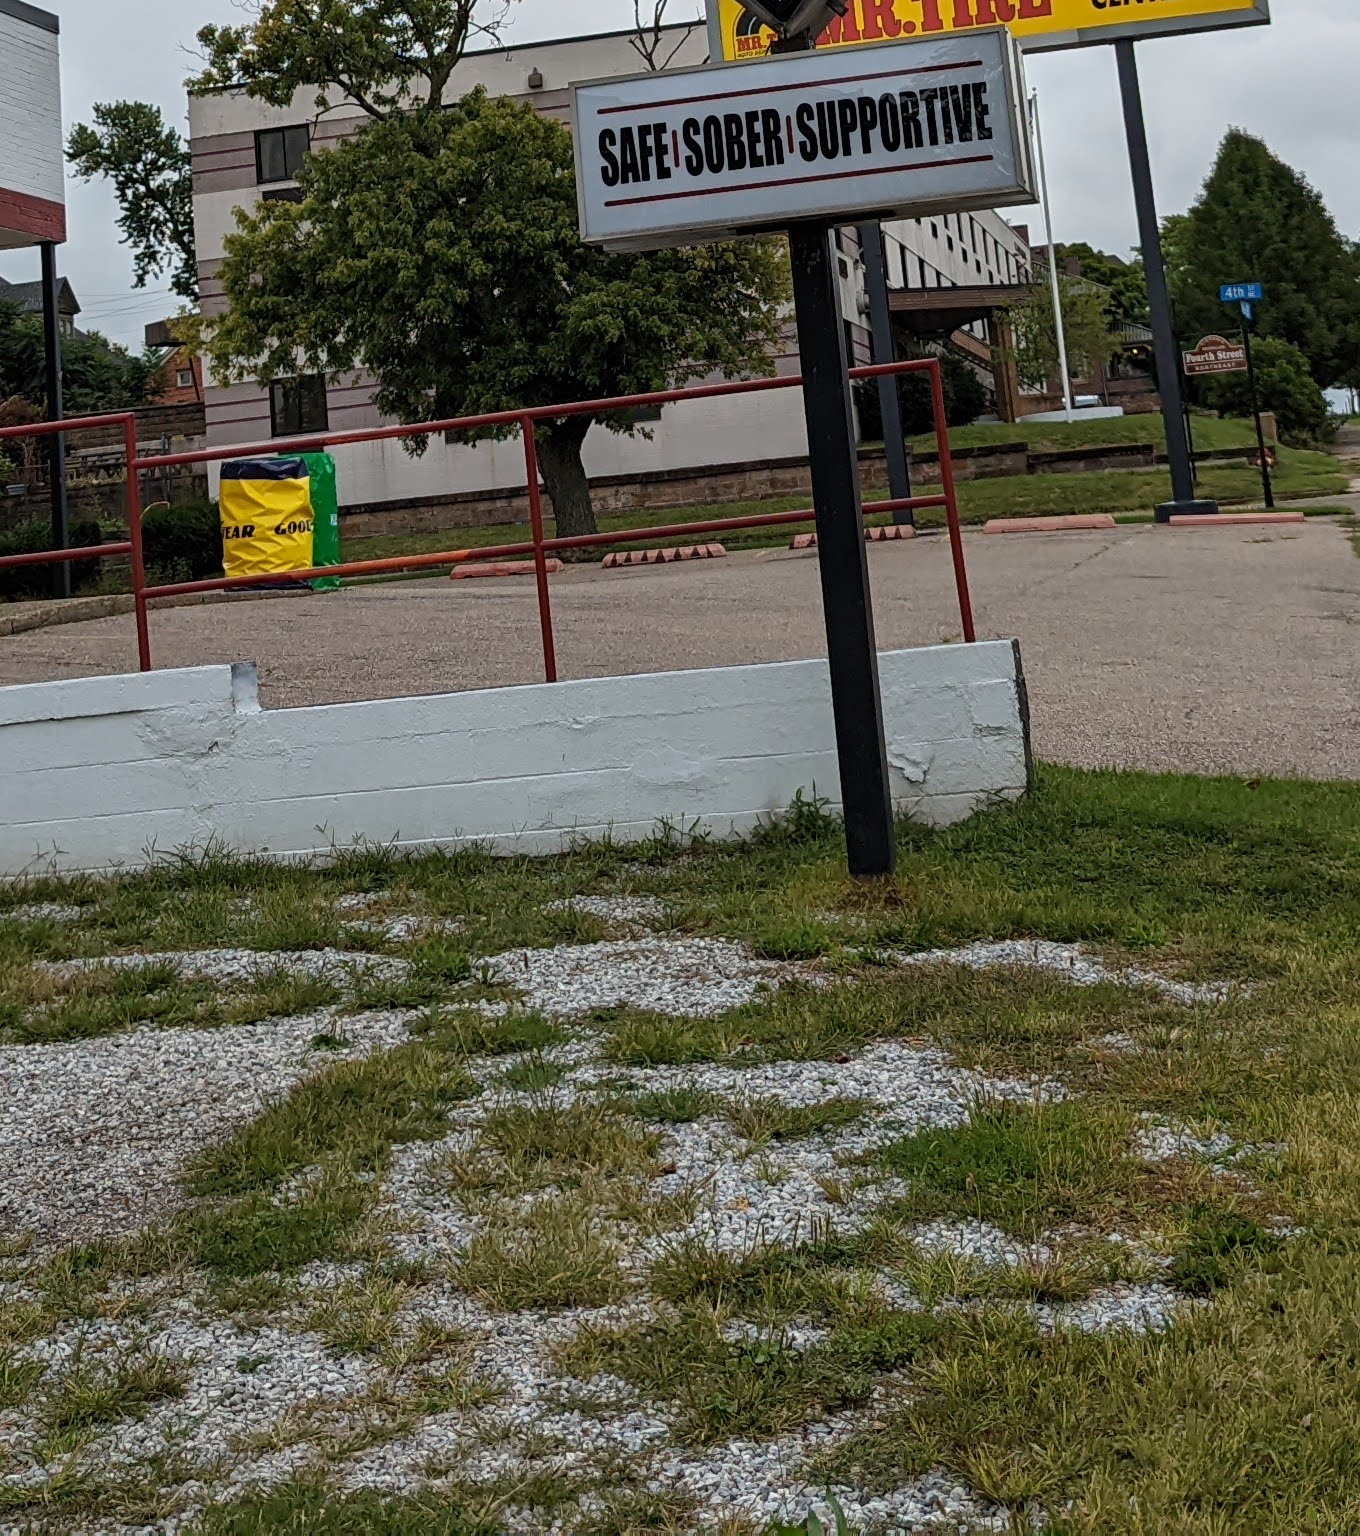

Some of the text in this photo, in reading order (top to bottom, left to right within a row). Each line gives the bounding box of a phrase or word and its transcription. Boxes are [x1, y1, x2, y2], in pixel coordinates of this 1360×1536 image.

[599, 81, 992, 187] SAFE SOBER SUPPORTIVE
[1225, 287, 1244, 298] 4th
[1185, 349, 1244, 363] Fourth Street
